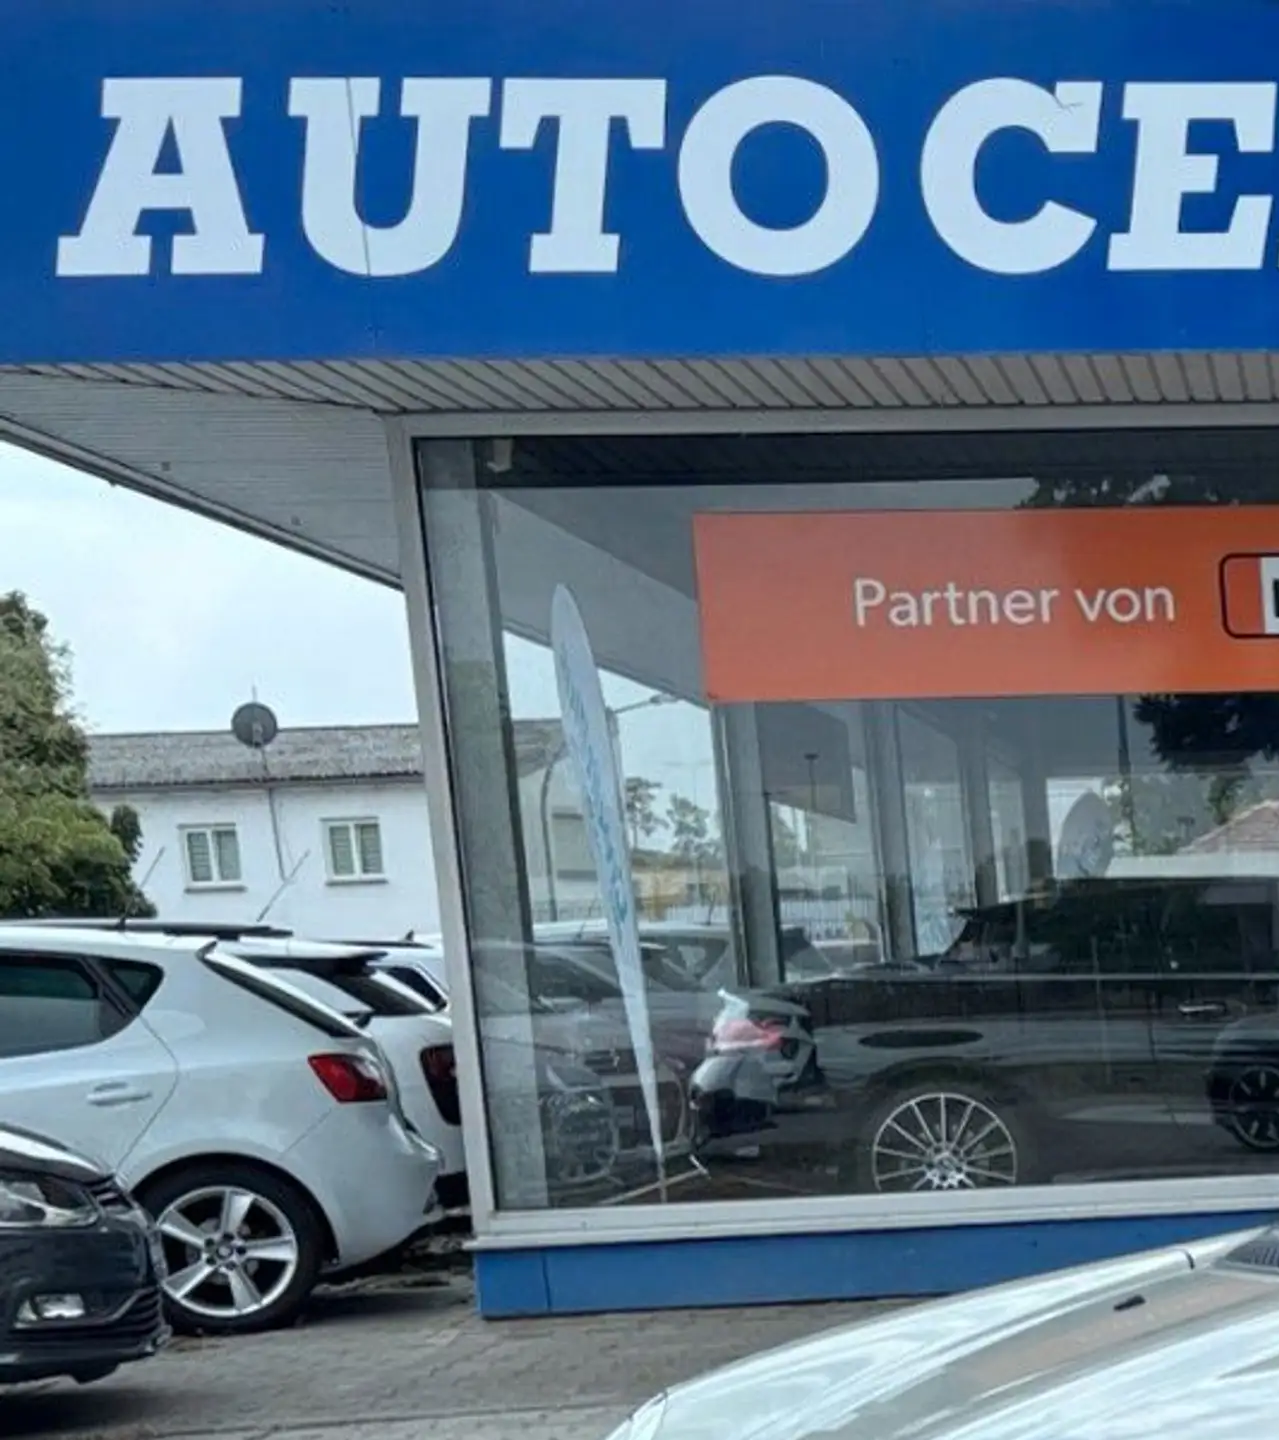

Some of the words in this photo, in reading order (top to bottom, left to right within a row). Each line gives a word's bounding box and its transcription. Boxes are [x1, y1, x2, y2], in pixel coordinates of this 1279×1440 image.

[57, 76, 879, 276] AUTO
[854, 578, 1060, 627] Partner
[1075, 588, 1175, 622] von
